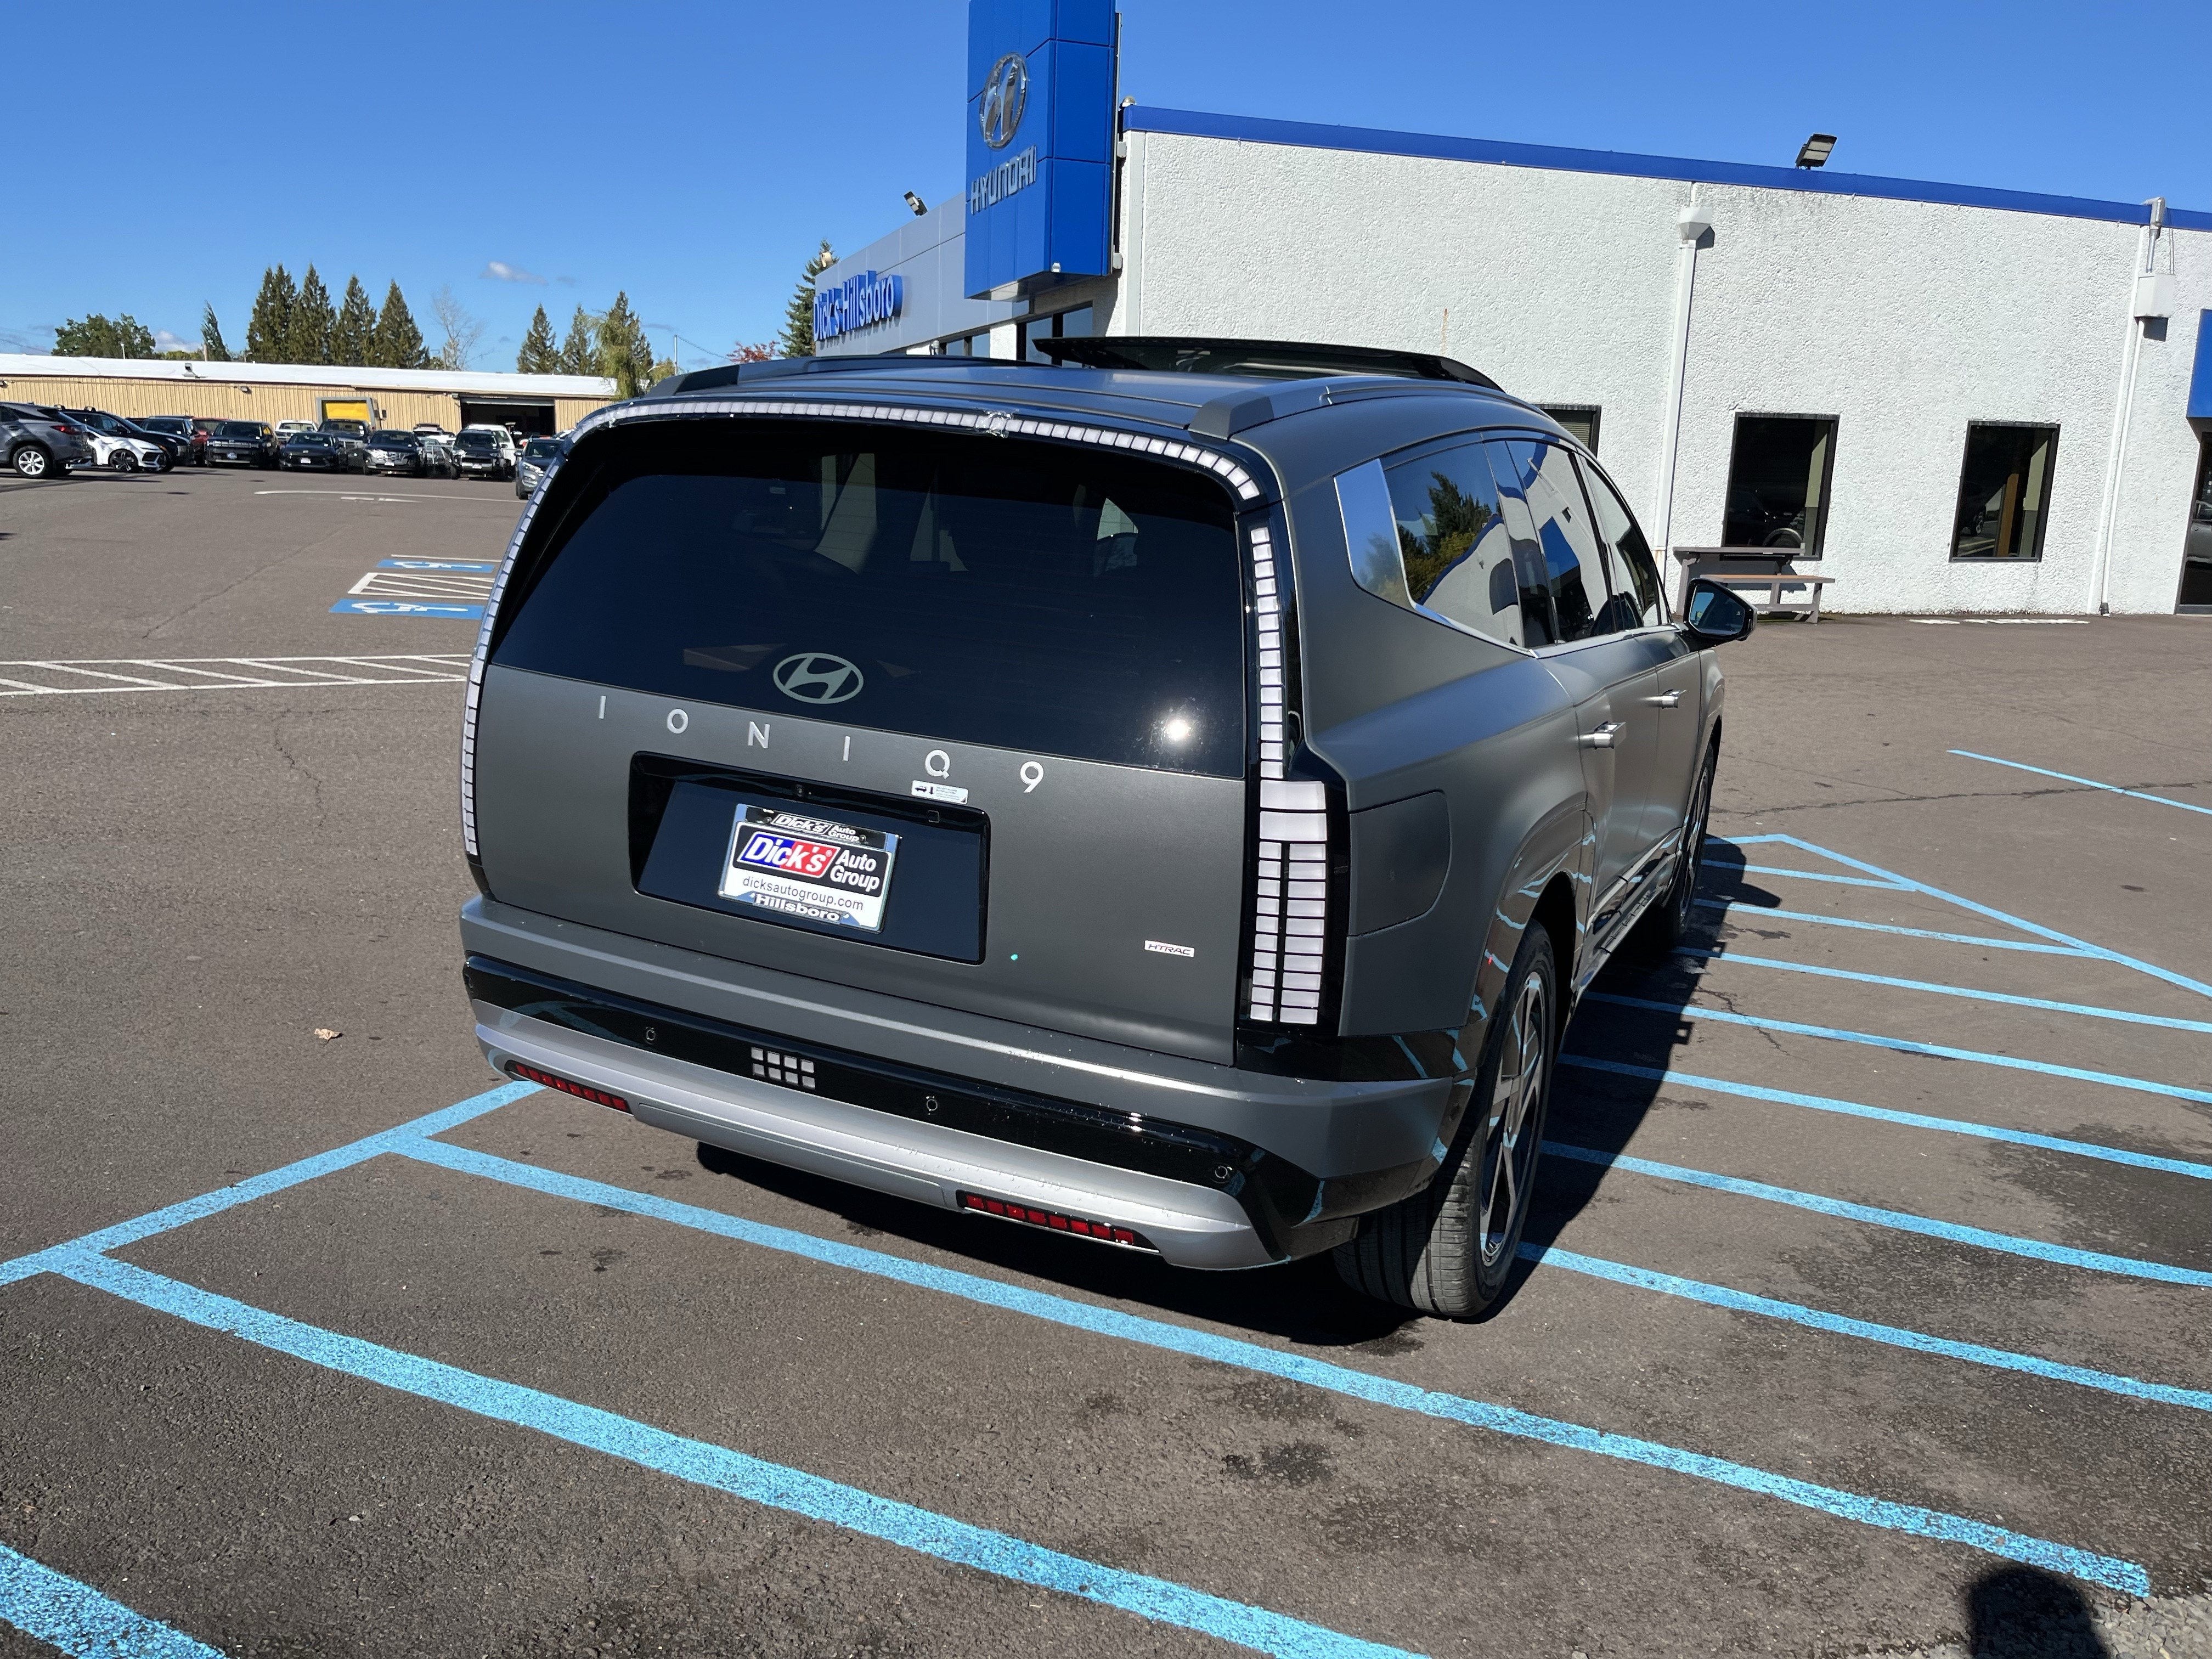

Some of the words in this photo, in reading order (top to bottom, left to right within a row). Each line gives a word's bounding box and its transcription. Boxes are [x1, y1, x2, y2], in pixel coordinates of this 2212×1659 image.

[970, 145, 1036, 215] HYUNDAI
[814, 288, 840, 341] Dick's
[843, 270, 895, 332] Hillsboro
[598, 695, 951, 780] IONIQ
[1020, 761, 1045, 794] 9
[777, 815, 828, 834] Dick's
[828, 829, 859, 842] Group
[832, 825, 856, 834] Auto
[835, 849, 877, 872] Auto
[830, 865, 880, 892] Group
[743, 876, 864, 911] dicksautogroup.com
[755, 894, 840, 922] Hillsboro
[1148, 944, 1191, 955] HTRAC
